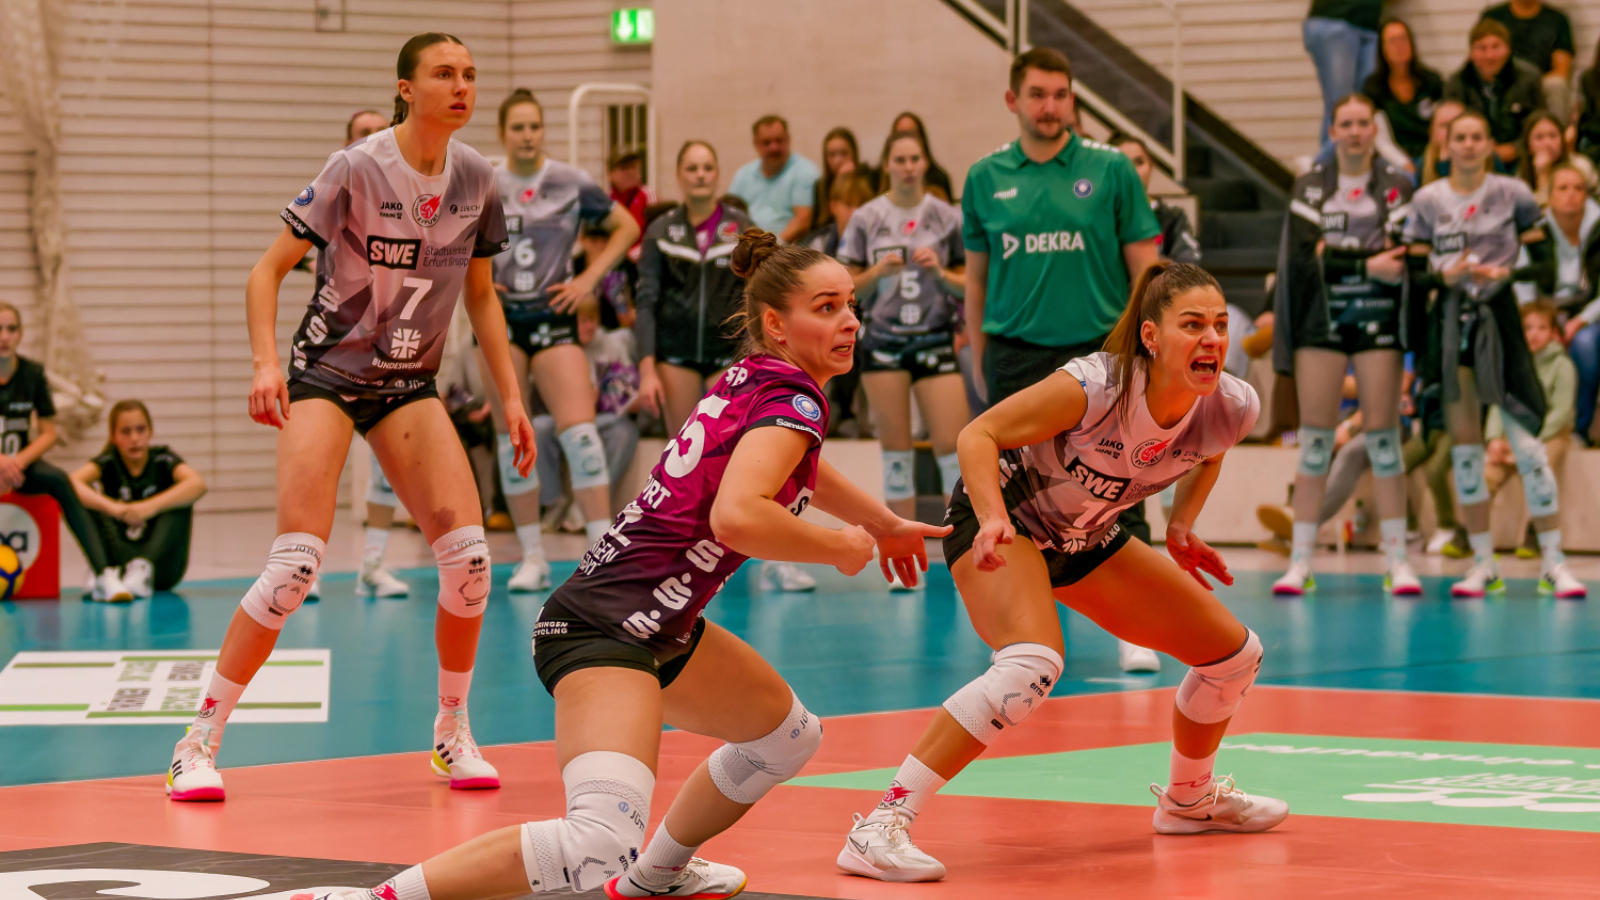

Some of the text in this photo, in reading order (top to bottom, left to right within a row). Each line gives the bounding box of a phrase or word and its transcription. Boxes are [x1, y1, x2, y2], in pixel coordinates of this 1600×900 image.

[380, 202, 403, 211] JAKO
[370, 240, 416, 265] SWE
[424, 245, 467, 257] Stadtwerke
[514, 239, 536, 267] 6
[1025, 231, 1085, 253] DEKRA
[423, 257, 469, 268] Erfurt Grupp
[901, 270, 921, 299] 5
[399, 277, 433, 321] 7
[371, 357, 423, 370] BUNDESWEHR
[663, 394, 731, 478] 5
[1098, 438, 1124, 450] JAKO
[1071, 464, 1124, 499] SWE
[1101, 523, 1120, 549] JAKO
